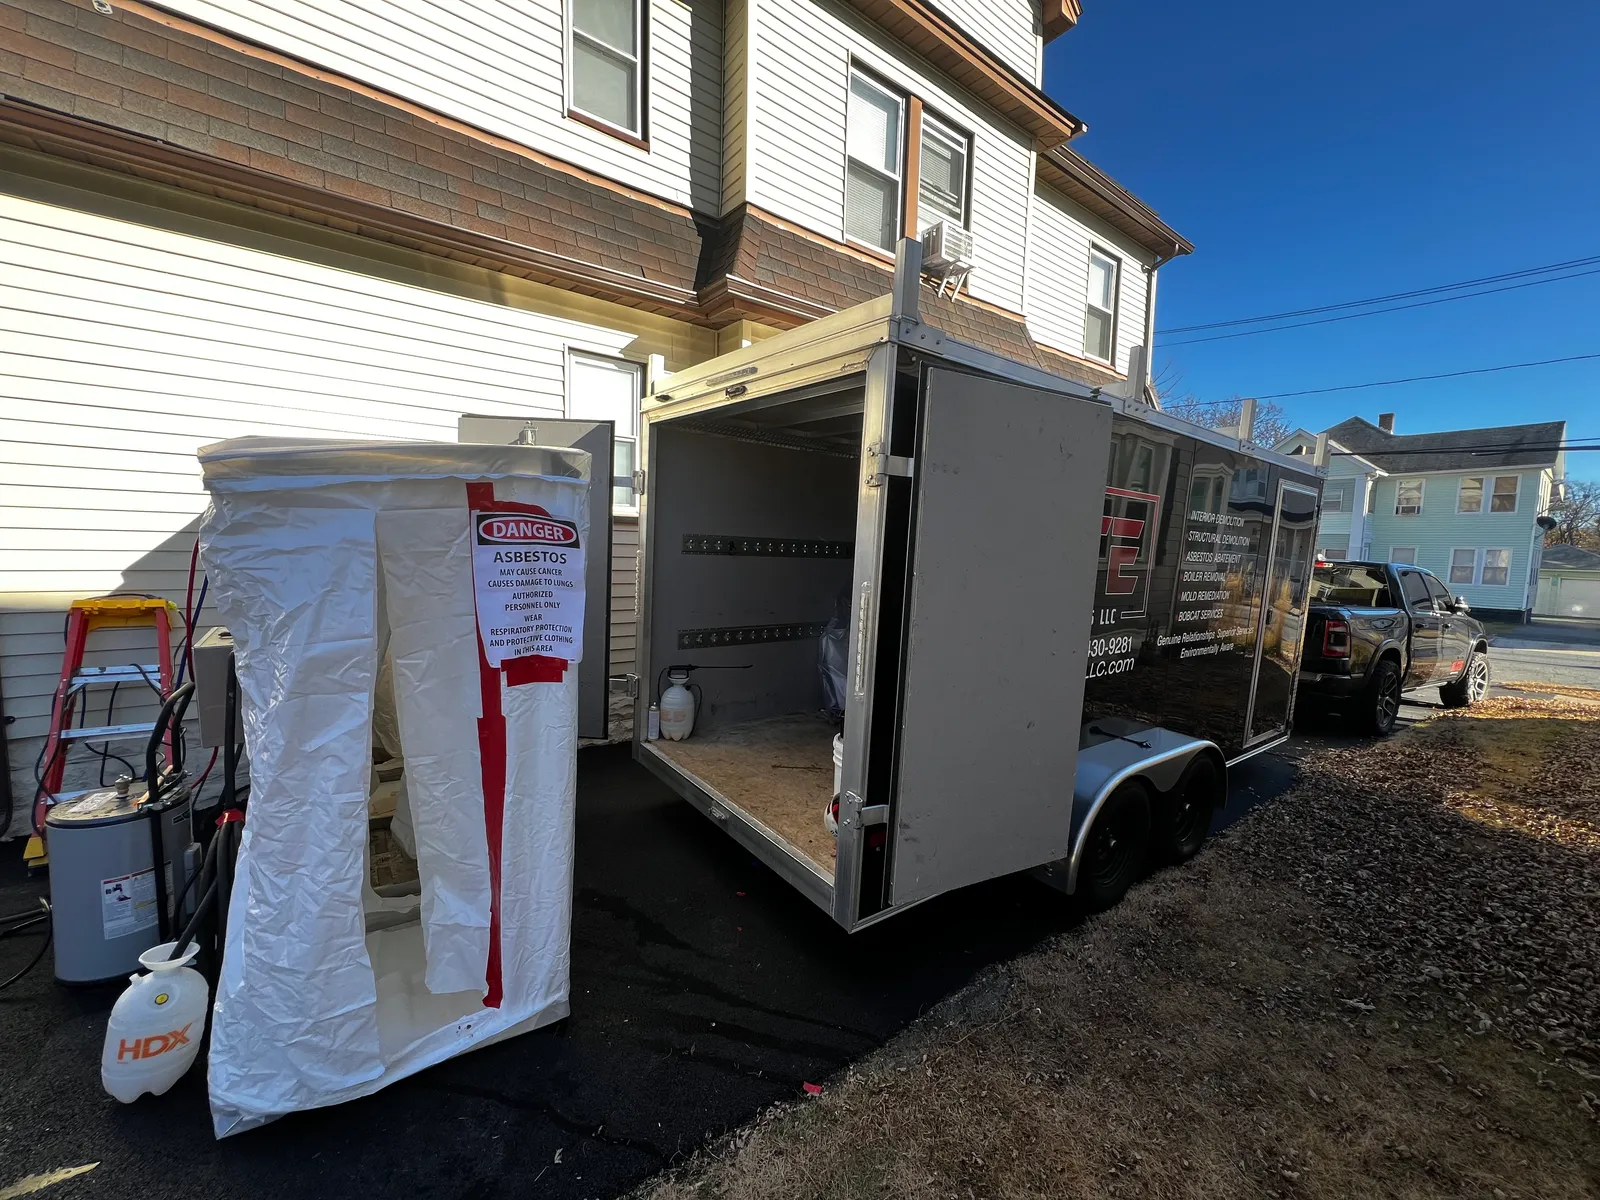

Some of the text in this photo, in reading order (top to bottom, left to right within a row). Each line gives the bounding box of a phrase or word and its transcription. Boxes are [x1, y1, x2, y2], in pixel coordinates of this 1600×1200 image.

[1190, 510, 1245, 527] INTERIOR DEMOLITION
[492, 521, 565, 541] DANGER
[1187, 530, 1250, 547] STRUCTURAL DEMOLITION
[493, 551, 567, 565] ASBESTOS
[1185, 551, 1241, 563] ASBESTOS ABATEMENT
[499, 567, 563, 577] MAY CAUSE CANCER
[1183, 571, 1225, 582] BOILER REMOVAL
[488, 578, 574, 588] CAUSES DAMAGE TO LUNGS
[512, 590, 553, 600] AUTHORIZED
[1180, 590, 1231, 602] MOLD REMEDIATION
[504, 601, 561, 612] PERSONNEL ONLY
[523, 614, 543, 622] WEAR
[1100, 608, 1117, 625] LLC
[1178, 608, 1224, 622] BOBCAT SERVICES
[490, 624, 573, 636] RESPIRATORY PROTECTION
[1156, 626, 1254, 647] Genuine Relationships Superior Services
[489, 633, 573, 647] AND PROTECTIVE CLOTHING
[514, 644, 553, 656] IN THIS AREA
[1180, 642, 1235, 659] Environmentally Aware
[116, 1021, 194, 1062] HDX
